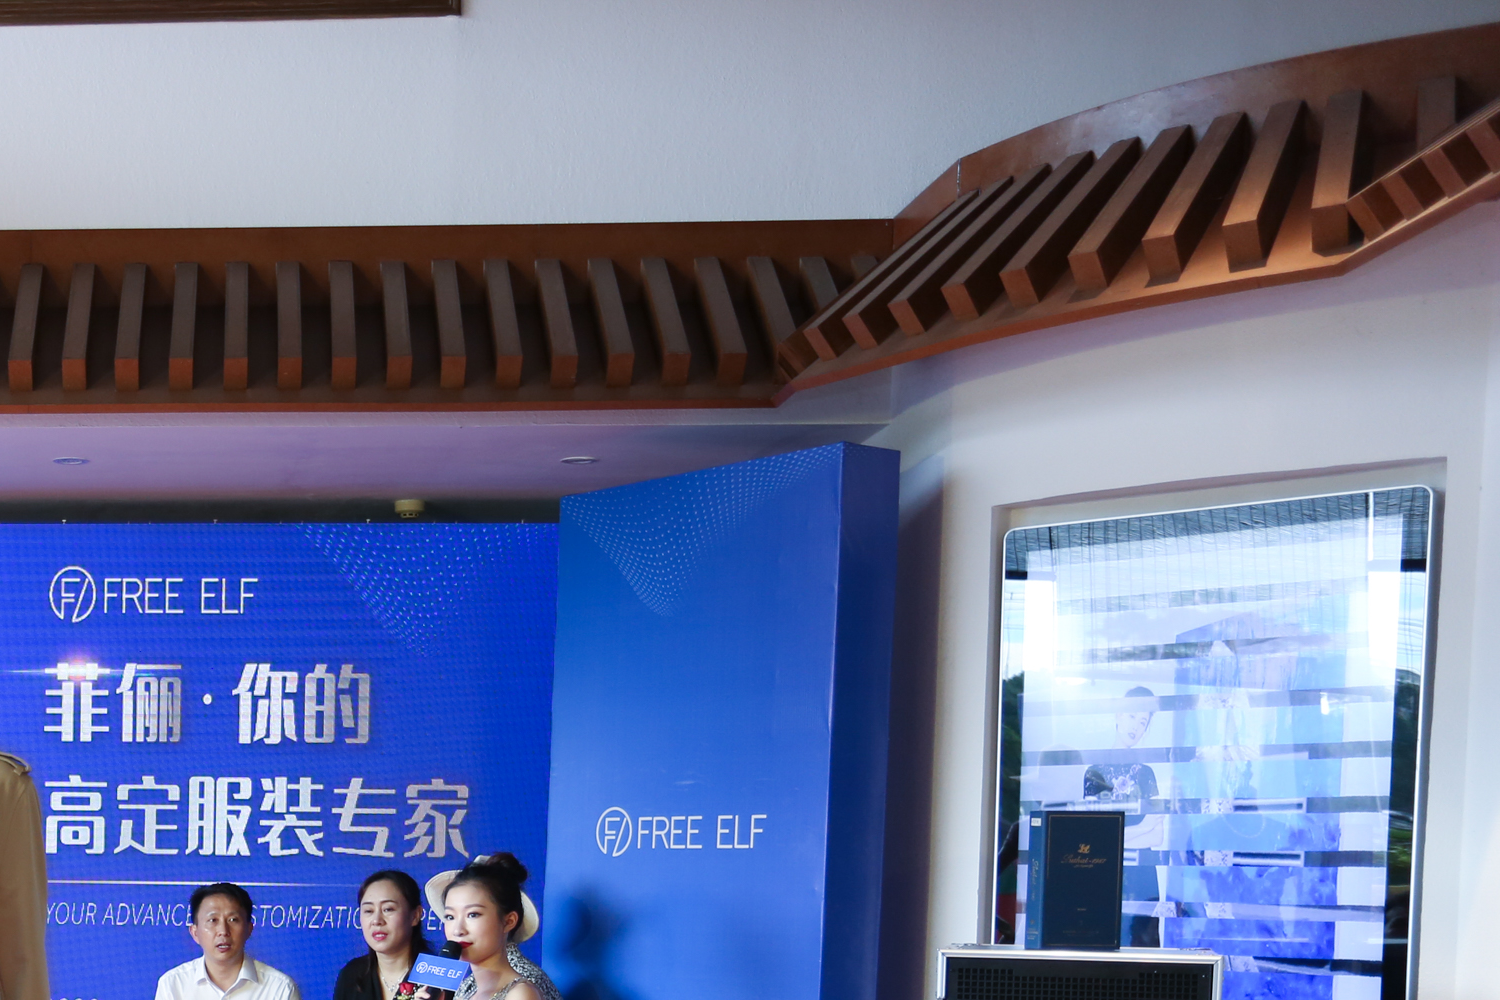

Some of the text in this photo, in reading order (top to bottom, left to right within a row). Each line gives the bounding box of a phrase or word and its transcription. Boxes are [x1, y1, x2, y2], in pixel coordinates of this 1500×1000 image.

[102, 577, 259, 615] FREE ELF
[44, 774, 470, 859] 高定服装专家
[636, 813, 767, 850] FREE ELF
[46, 901, 98, 926] YOUR
[101, 902, 194, 927] ADVANCE
[427, 965, 463, 979] FREE ELF
